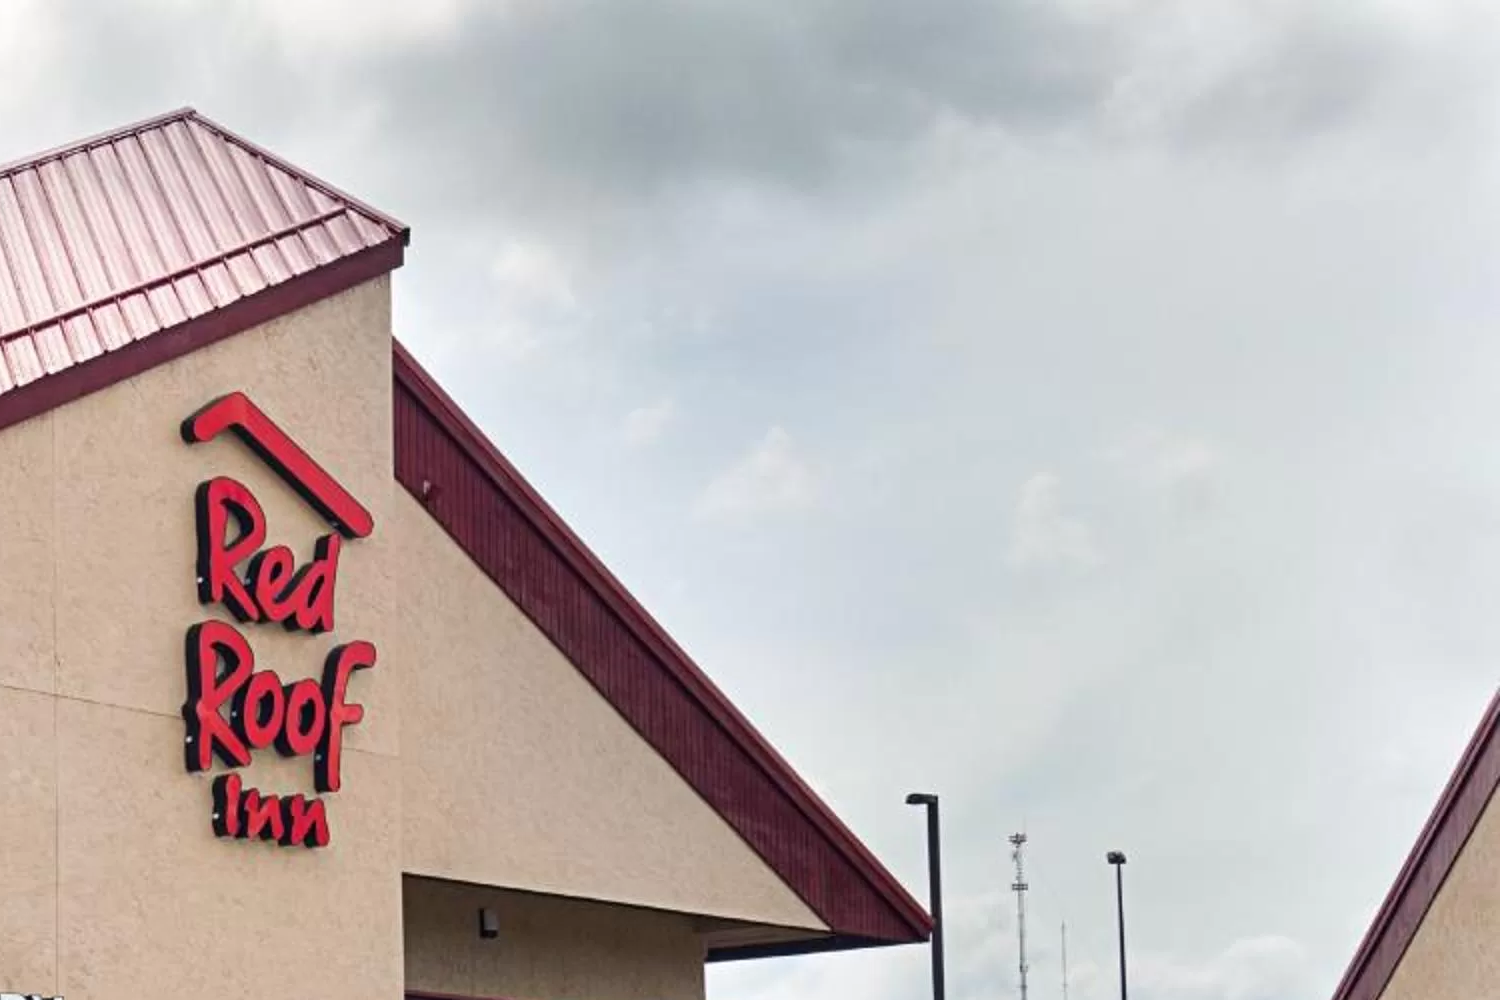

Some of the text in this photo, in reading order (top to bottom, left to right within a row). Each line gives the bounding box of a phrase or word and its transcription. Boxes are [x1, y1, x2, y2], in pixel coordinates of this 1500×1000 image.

[198, 476, 341, 633] Red
[184, 620, 376, 792] Roof
[213, 773, 330, 847] Inn
